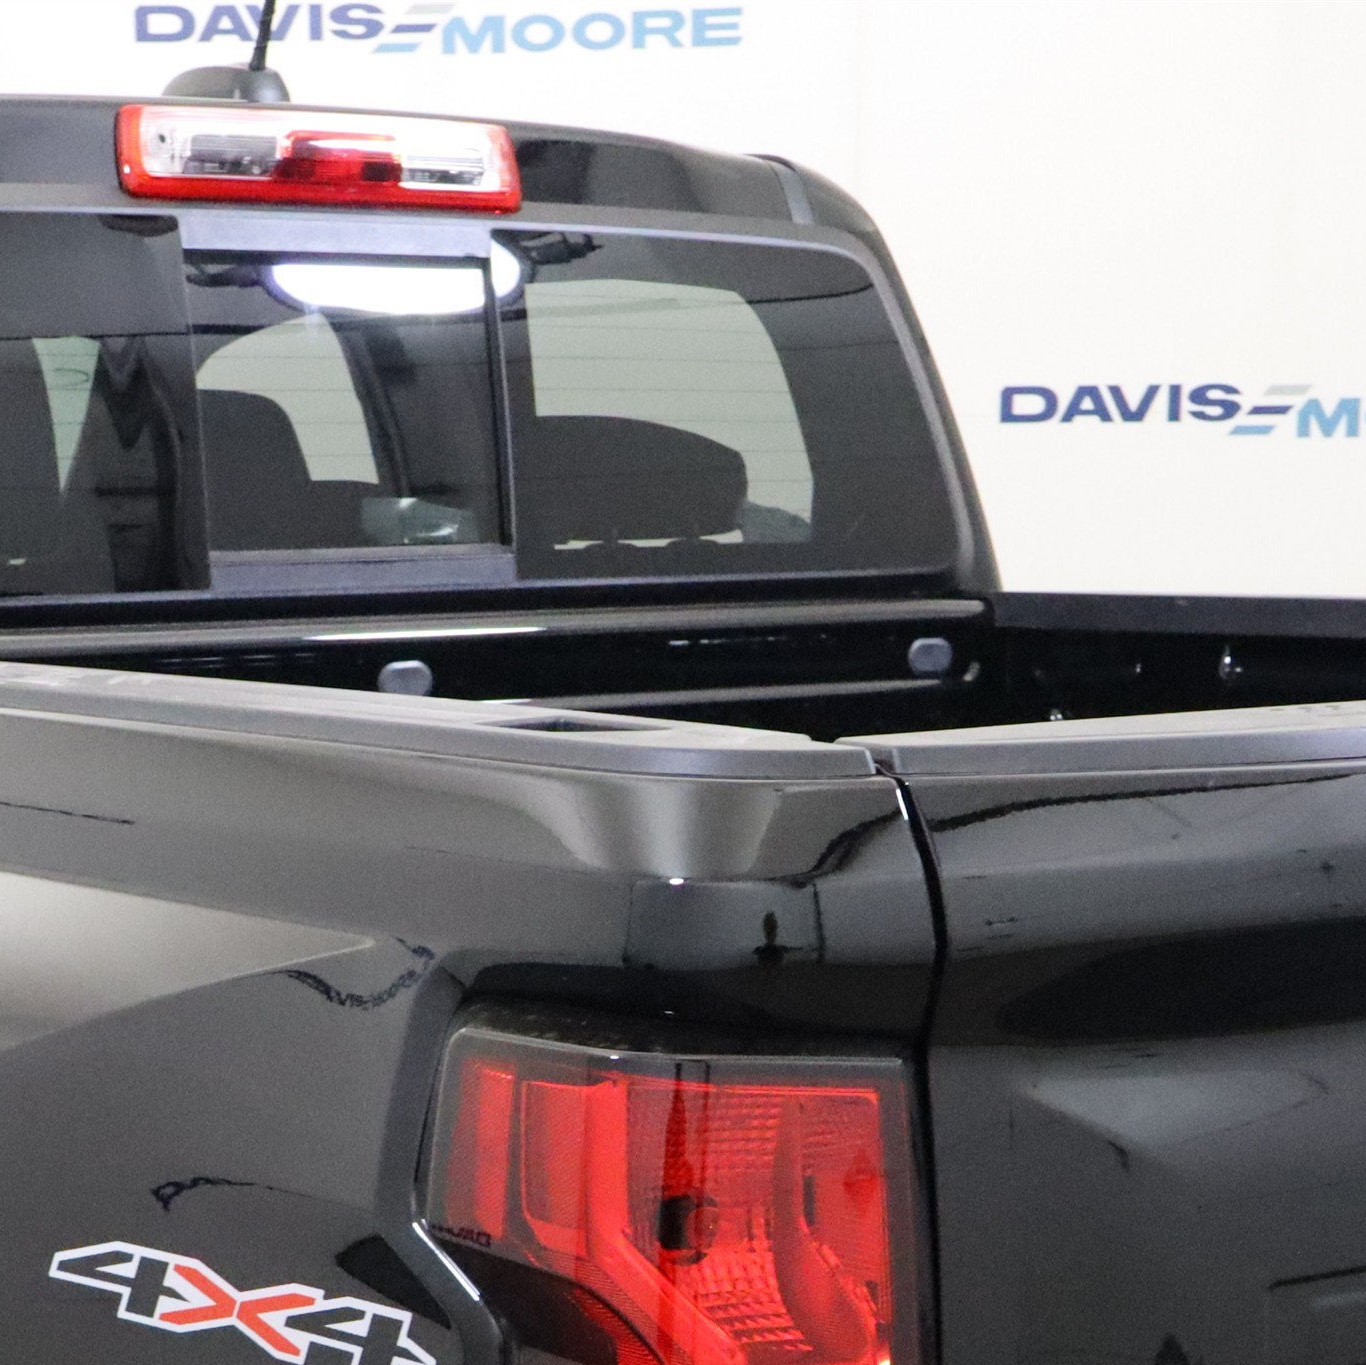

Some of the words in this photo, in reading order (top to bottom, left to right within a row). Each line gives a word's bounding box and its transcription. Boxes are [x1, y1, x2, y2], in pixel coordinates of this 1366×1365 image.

[135, 3, 383, 42] DAVIS
[441, 7, 742, 54] MOORE
[999, 383, 1240, 423] DAVIS
